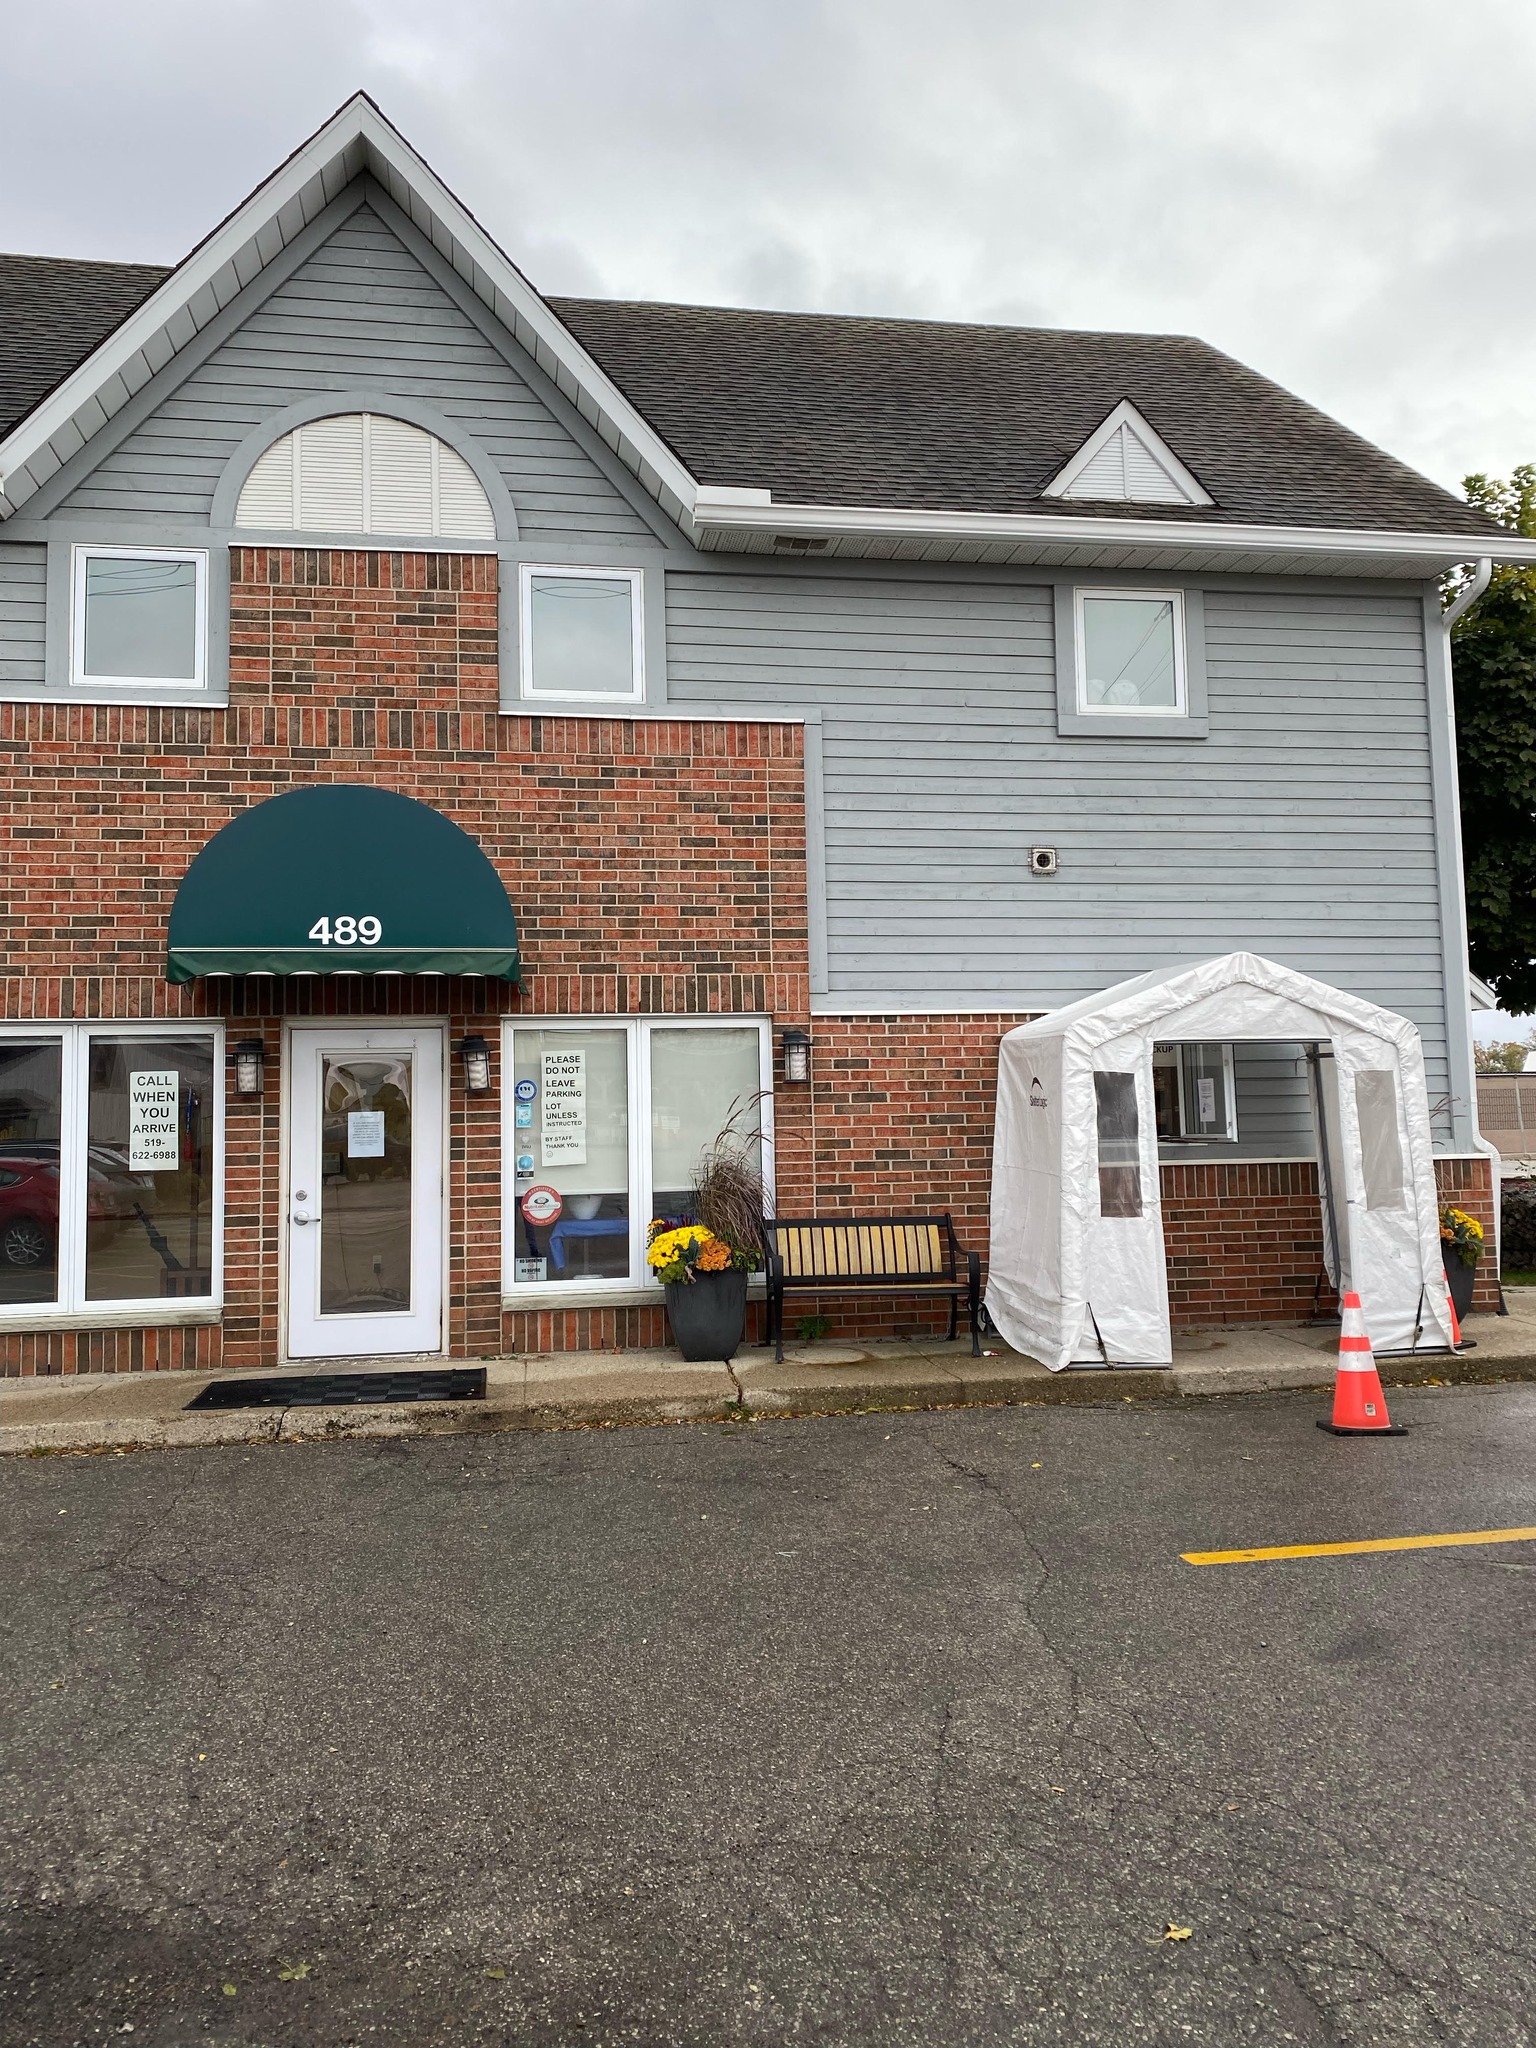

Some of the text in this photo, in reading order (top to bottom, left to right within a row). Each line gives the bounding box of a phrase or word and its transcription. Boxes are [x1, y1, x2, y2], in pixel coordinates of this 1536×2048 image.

[308, 915, 382, 945] 489
[1153, 1045, 1174, 1054] CKUP
[545, 1055, 581, 1064] PLEASE
[545, 1066, 580, 1075] DO NOT
[137, 1076, 172, 1086] CALL
[546, 1079, 576, 1088] LEAVE
[133, 1091, 175, 1102] WHEN
[546, 1090, 582, 1098] PARKING
[546, 1102, 561, 1110] LOT
[140, 1107, 170, 1118] YOU
[545, 1111, 578, 1120] UNLESS
[132, 1123, 176, 1133] ARRIVE
[144, 1138, 165, 1147] 519-
[132, 1150, 176, 1160] 622-6988
